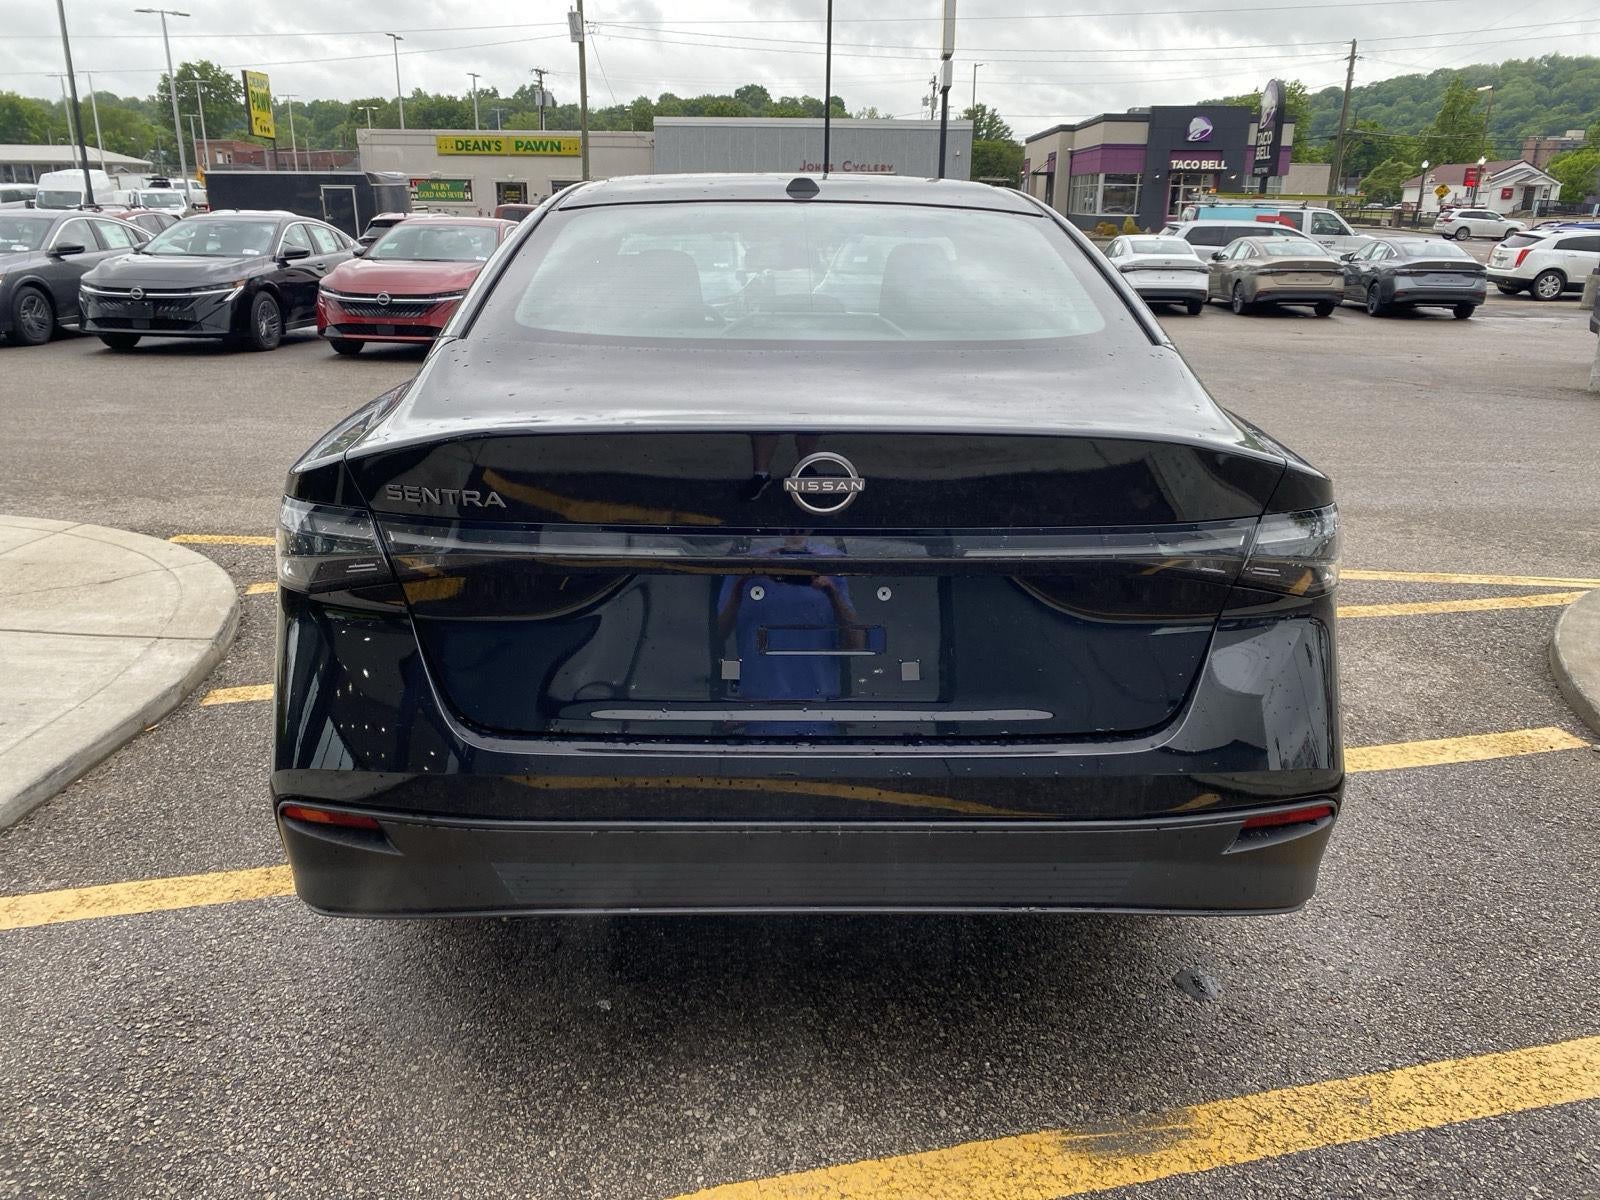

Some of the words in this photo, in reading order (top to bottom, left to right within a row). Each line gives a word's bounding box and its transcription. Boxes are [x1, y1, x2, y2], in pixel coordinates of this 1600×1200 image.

[1257, 131, 1272, 145] TACO
[455, 140, 502, 152] DEAN'S
[515, 140, 562, 152] PAWN
[1255, 146, 1270, 160] BELL
[800, 160, 833, 171] JOHS
[842, 160, 893, 173] CYCLERY
[1170, 159, 1200, 170] TACO
[1200, 159, 1228, 170] BELL
[418, 191, 434, 199] GOLD
[435, 191, 447, 199] AND
[447, 191, 464, 199] SILVER
[786, 480, 863, 491] NISSAN
[385, 484, 507, 508] SENTRA
